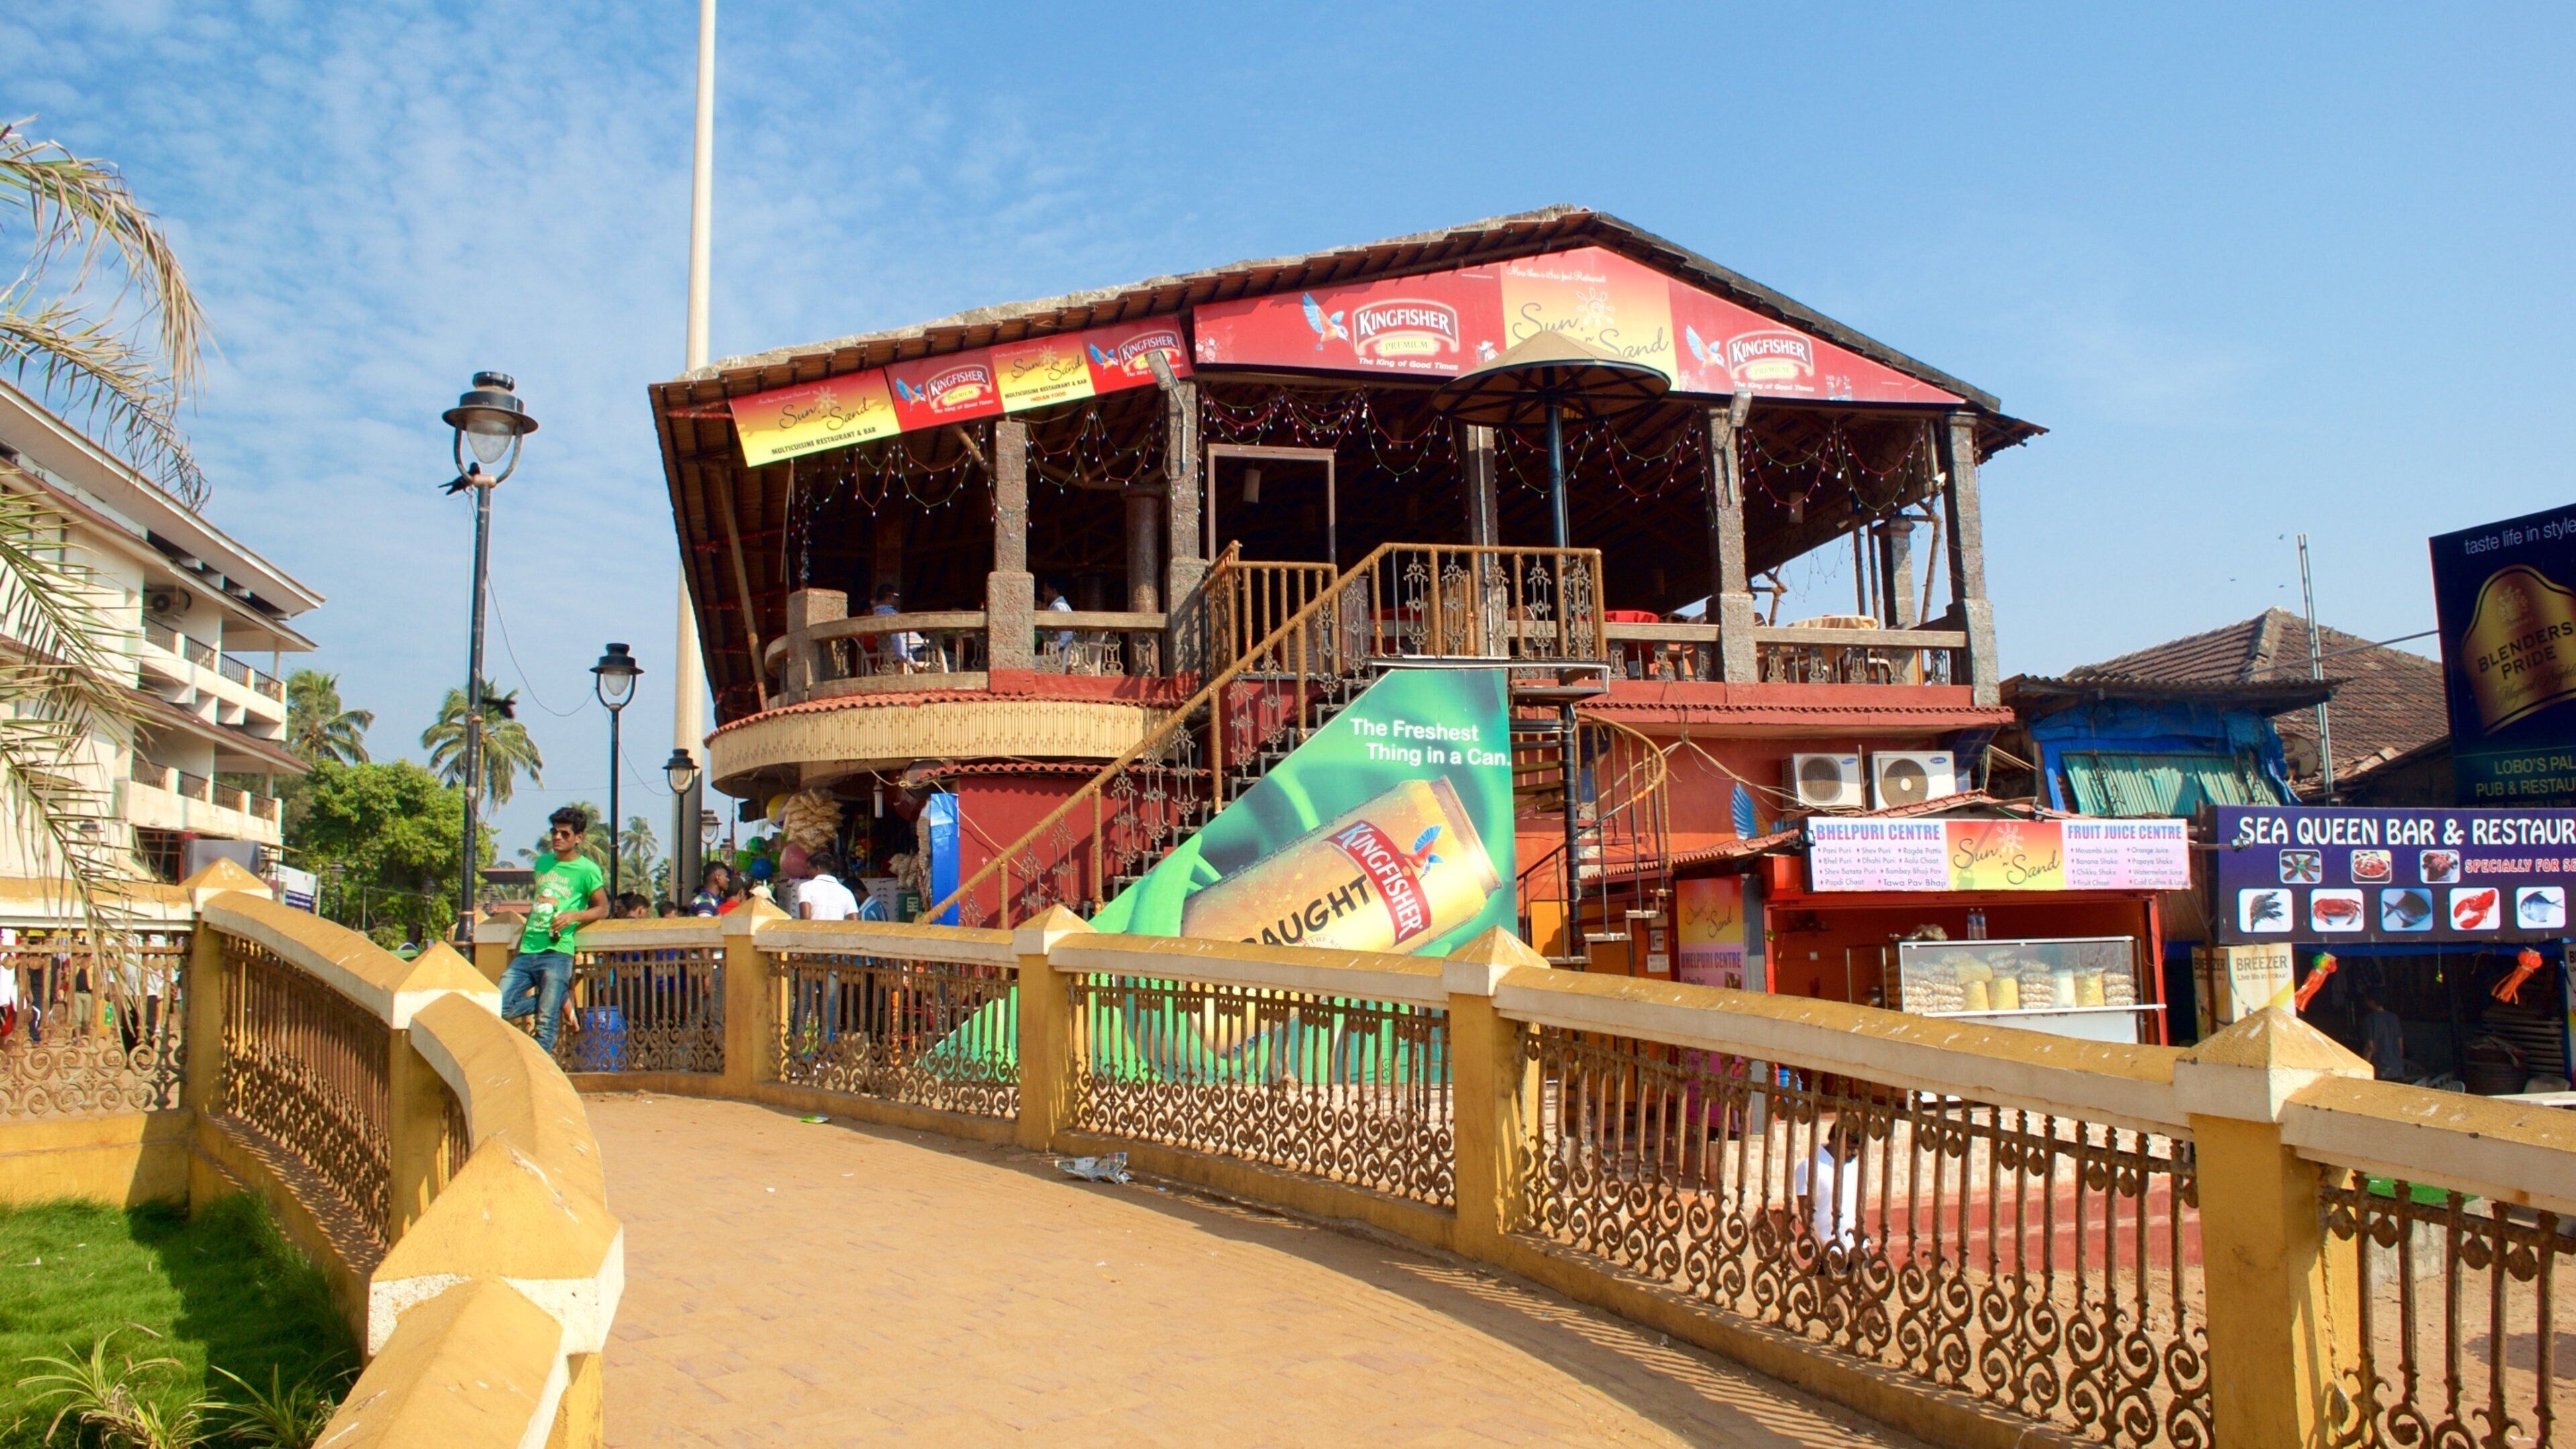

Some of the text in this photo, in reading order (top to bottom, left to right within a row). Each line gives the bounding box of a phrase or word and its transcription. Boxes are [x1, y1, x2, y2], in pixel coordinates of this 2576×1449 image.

[1359, 309, 1452, 336] KINGFISHER
[1121, 335, 1175, 361] KINGFISHER
[1385, 341, 1428, 351] PREMIUM
[1599, 327, 1669, 358] Sand
[1732, 338, 1807, 362] KINGFISHER
[1048, 354, 1083, 381] Sand
[1358, 357, 1374, 365] The
[1377, 358, 1395, 368] King
[1397, 359, 1407, 367] of
[1434, 362, 1458, 370] Times
[930, 370, 987, 396] KINGFISHER
[1040, 382, 1071, 392] RESTAURANT
[1748, 382, 1763, 390] King
[947, 389, 973, 402] PREMIUM
[1030, 394, 1050, 402] INDIAN
[826, 396, 871, 431] Sand
[771, 441, 815, 455] MULTICUISINE
[816, 431, 855, 446] RESTAURANT
[863, 427, 877, 435] BAR
[2464, 517, 2576, 555] taste life in style
[2477, 621, 2574, 673] BLENDERS
[2501, 645, 2557, 680] PRIDE
[1350, 718, 1480, 742] The Freshest
[1366, 743, 1511, 767] Thing in a Can.
[2494, 757, 2546, 775] LOBO'S
[2475, 782, 2505, 797] PUB
[2508, 781, 2518, 795] &
[1816, 824, 1940, 841] BHELPURI CENTRE
[2068, 824, 2182, 839] FRUIT JUICE CENTRE
[2238, 816, 2576, 846] SEA QUEEN BAR & RESTAUR
[1903, 847, 1923, 855] Ragda
[1953, 838, 1998, 870] Sun
[2131, 847, 2153, 855] Orange
[2006, 849, 2060, 885] Sand
[2133, 858, 2154, 866] Papaya
[2465, 859, 2532, 873] SPECIALLY
[2535, 858, 2560, 873] FOR
[1885, 867, 1911, 875] Bombay
[1913, 867, 1929, 875] Bhaji
[1337, 822, 1424, 939] KINGFISHER
[1825, 878, 1843, 887] Papdi
[1884, 879, 1905, 887] Tawa
[1925, 878, 1946, 888] Bhaji
[1681, 953, 1713, 968] BHELPURI
[1714, 952, 1741, 968] CENTRE
[2236, 955, 2288, 971] BREEZER
